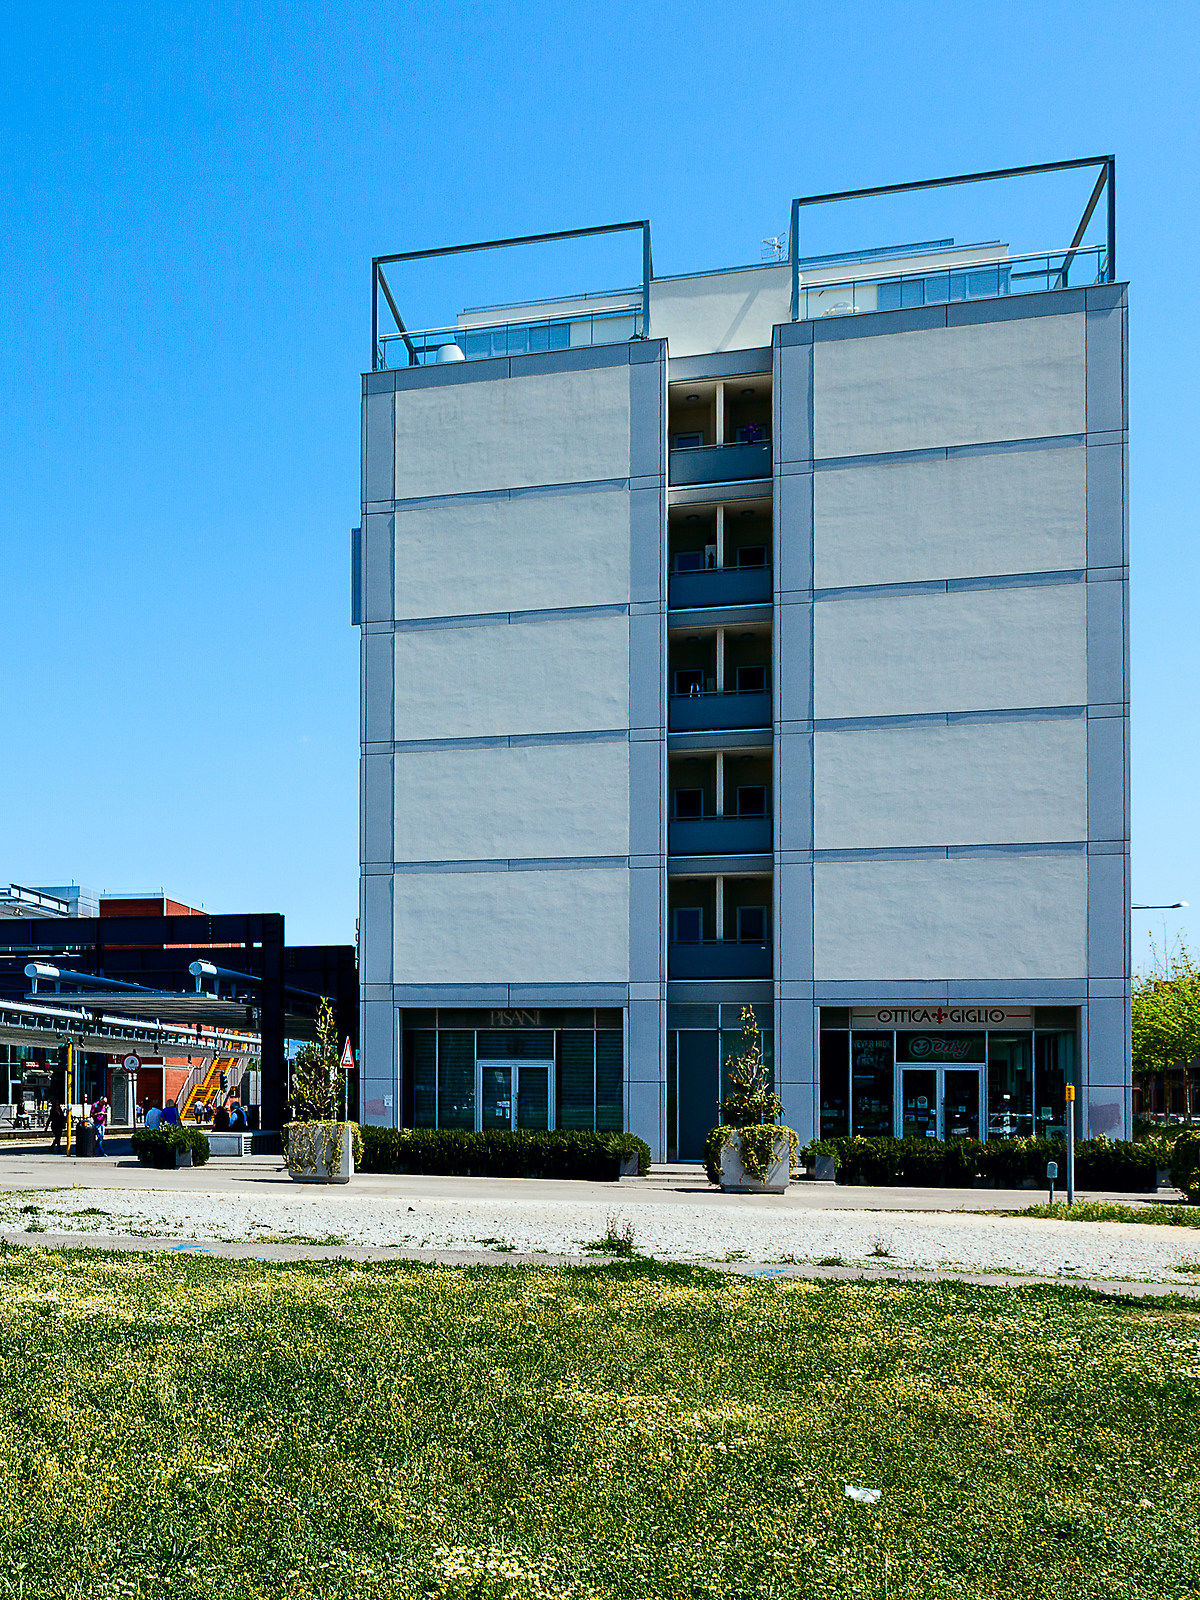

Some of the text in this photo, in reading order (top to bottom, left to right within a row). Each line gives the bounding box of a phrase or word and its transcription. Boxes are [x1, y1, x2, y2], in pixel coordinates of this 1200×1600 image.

[490, 1010, 542, 1026] PISANI
[877, 1009, 1006, 1023] OTTICA GIGLIO
